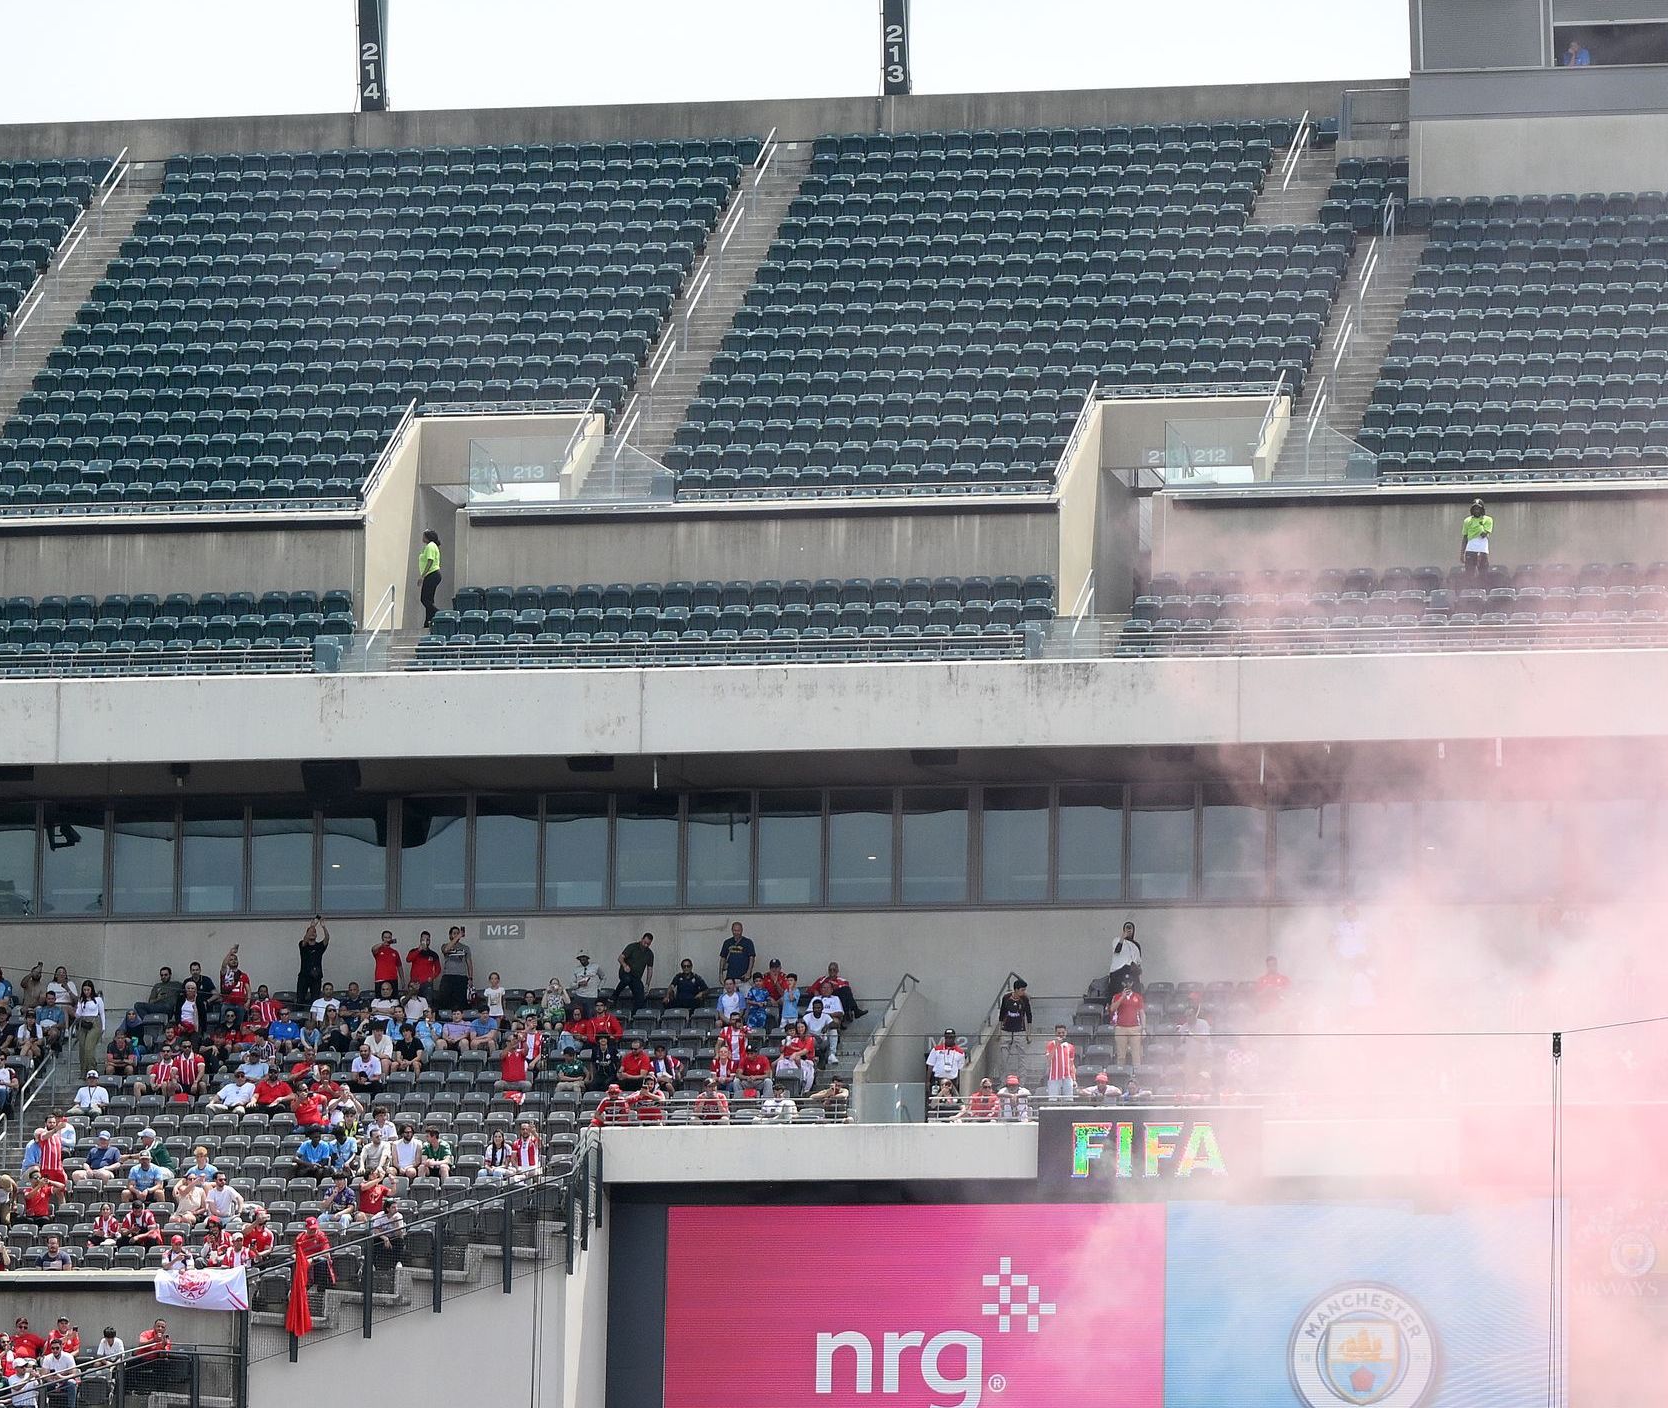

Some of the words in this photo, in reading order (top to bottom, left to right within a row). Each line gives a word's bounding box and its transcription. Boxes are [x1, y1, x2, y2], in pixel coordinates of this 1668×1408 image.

[362, 42, 381, 100] 214
[885, 24, 905, 83] 213
[513, 466, 545, 479] 213
[1194, 449, 1227, 463] 212
[486, 924, 520, 935] M12
[1070, 1121, 1228, 1179] FIFA
[1304, 1292, 1422, 1340] MANCHESTER
